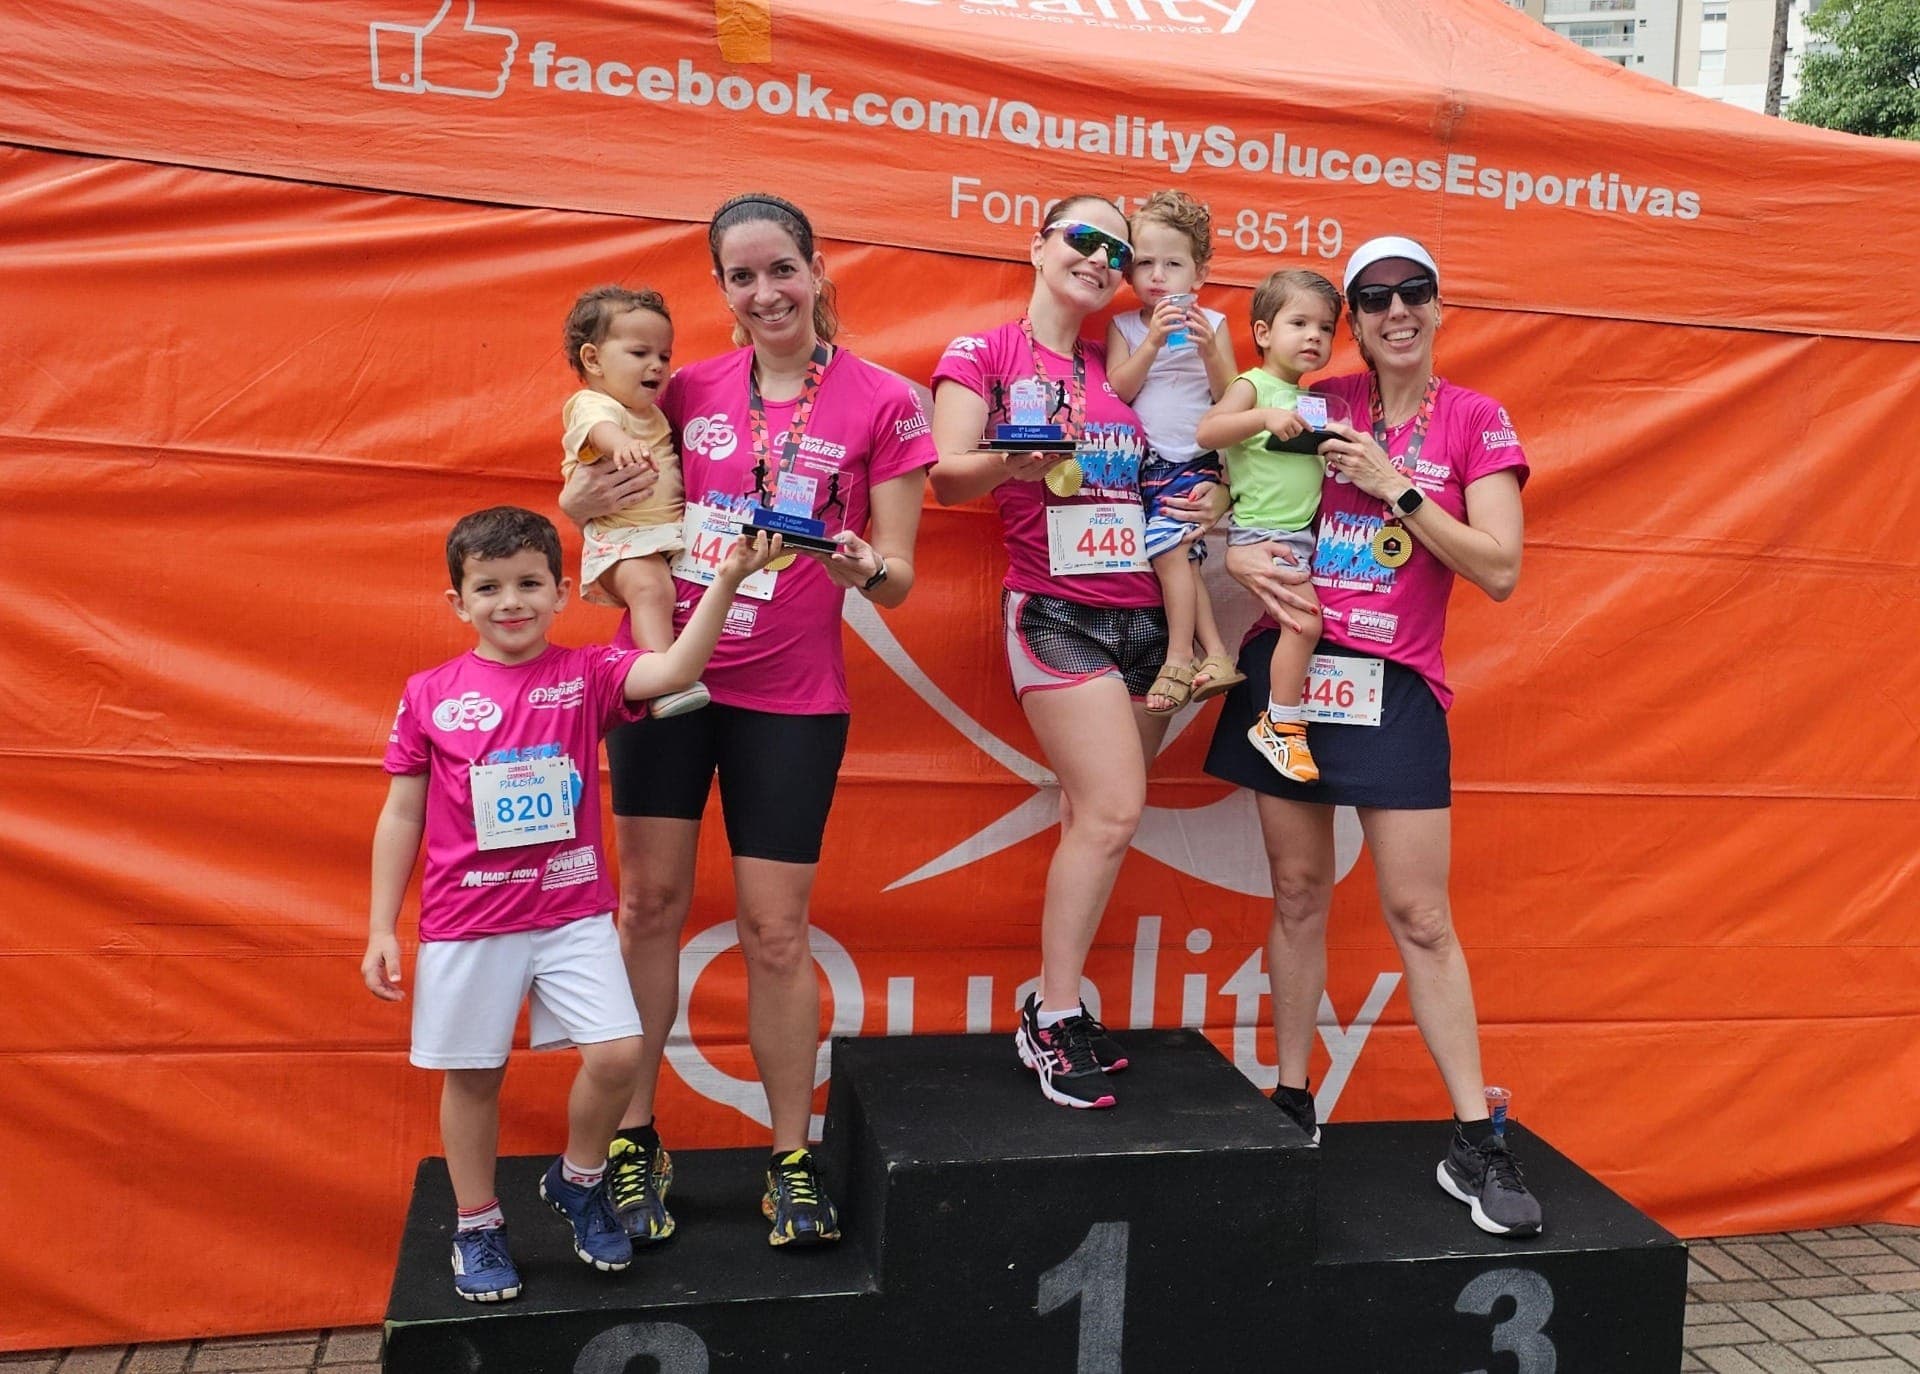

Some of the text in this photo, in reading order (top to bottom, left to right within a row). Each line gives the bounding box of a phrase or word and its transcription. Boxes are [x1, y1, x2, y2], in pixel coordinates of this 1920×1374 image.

[529, 42, 1701, 220] facebook.com/QualitySolucoesEsportivas
[951, 176, 1054, 227] Fon
[799, 441, 847, 459] AVARES
[691, 532, 740, 569] 44
[1076, 527, 1136, 557] 448
[1350, 613, 1396, 630] POWER
[1301, 676, 1354, 708] 446
[496, 793, 553, 823] 820
[512, 868, 538, 880] NOVA
[1038, 1221, 1130, 1374] 1
[1453, 1267, 1558, 1374] 3
